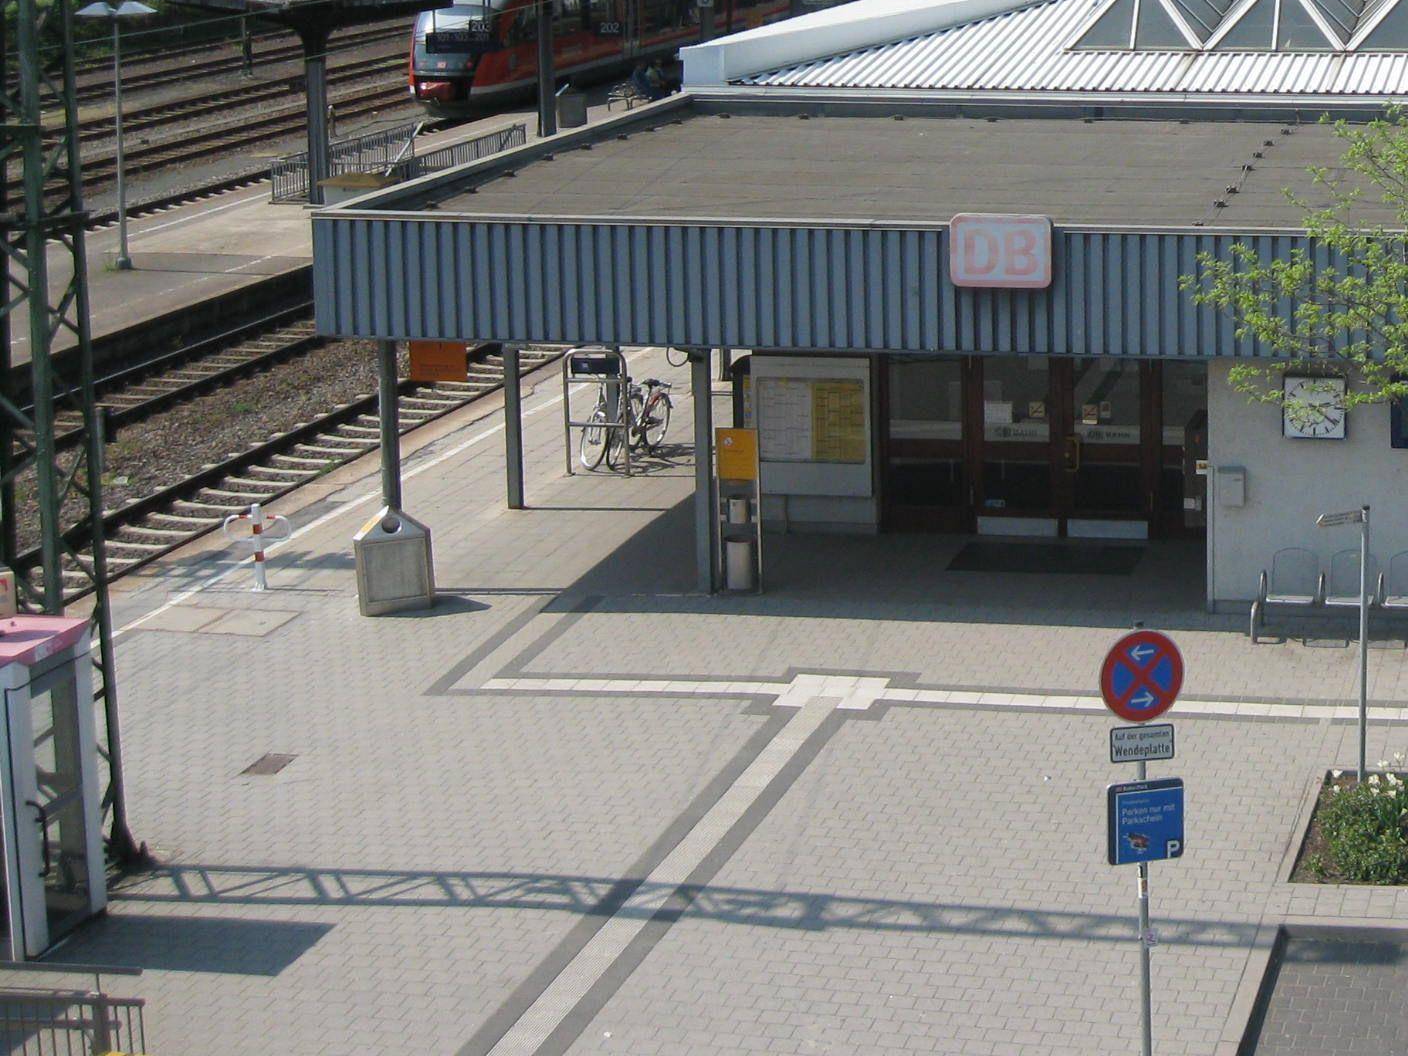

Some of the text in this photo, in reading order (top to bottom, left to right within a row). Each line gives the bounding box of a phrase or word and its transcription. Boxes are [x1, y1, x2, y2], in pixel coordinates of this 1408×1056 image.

[600, 23, 620, 33] 202
[964, 228, 1038, 276] DB
[1113, 743, 1170, 757] Wendeplatte
[1121, 807, 1148, 816] Parken
[1121, 815, 1163, 824] Parkschein
[1167, 840, 1180, 858] P
